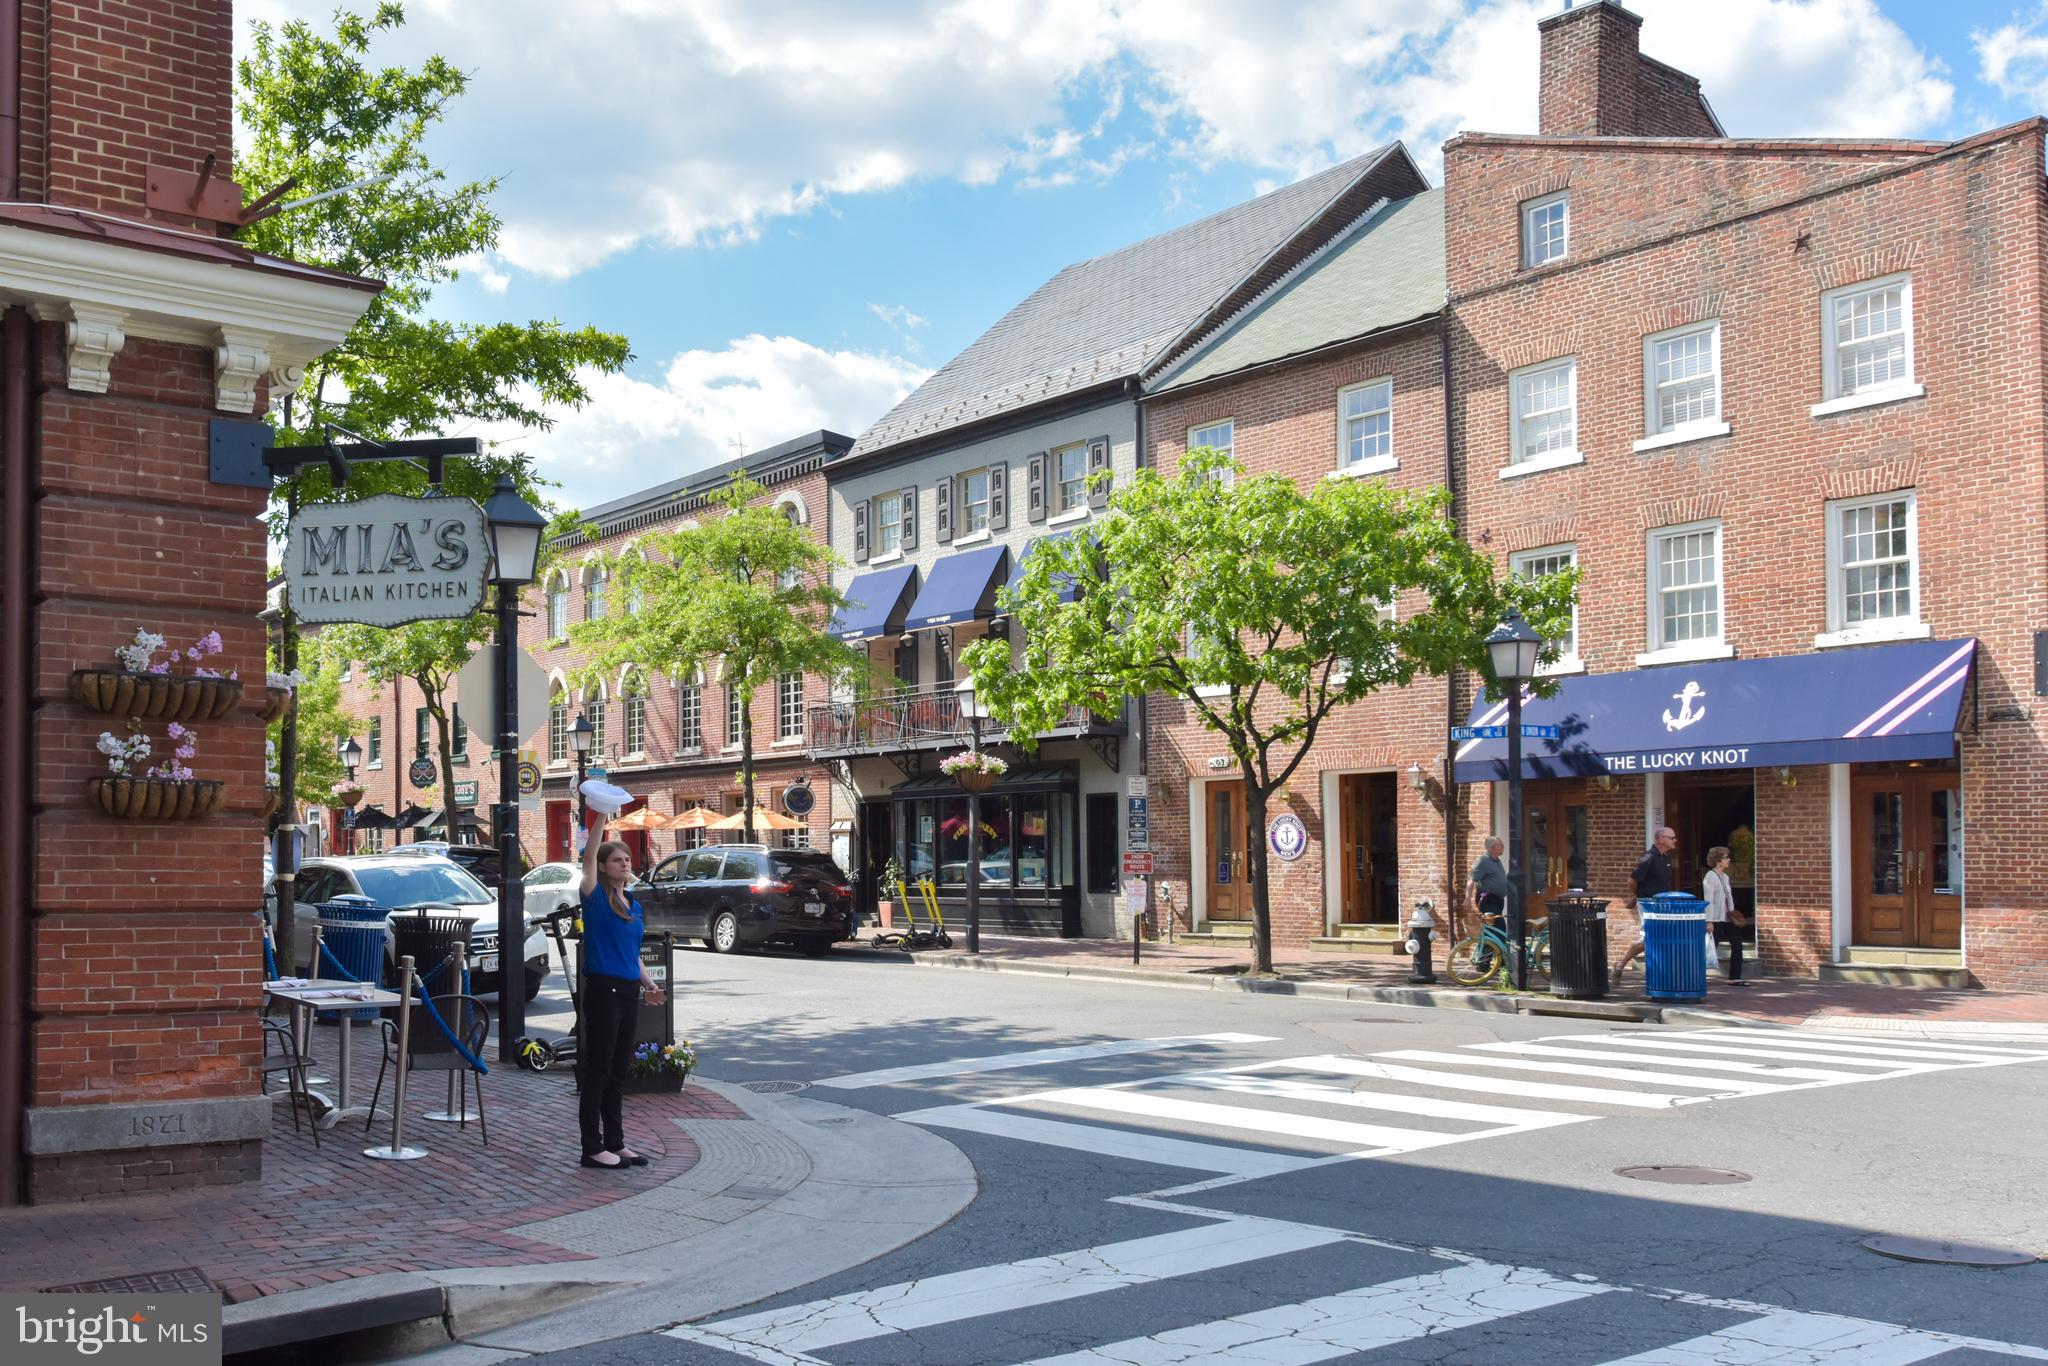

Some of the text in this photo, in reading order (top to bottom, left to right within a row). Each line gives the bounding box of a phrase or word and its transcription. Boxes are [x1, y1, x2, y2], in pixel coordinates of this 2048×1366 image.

[302, 518, 469, 576] MIA'S
[302, 581, 468, 603] ITALIAN KITCHEN
[1454, 727, 1475, 739] KING
[1604, 749, 1749, 770] THE LUCKY KNOT
[1134, 799, 1141, 809] P
[640, 954, 660, 962] TREET
[127, 1113, 187, 1137] 1871
